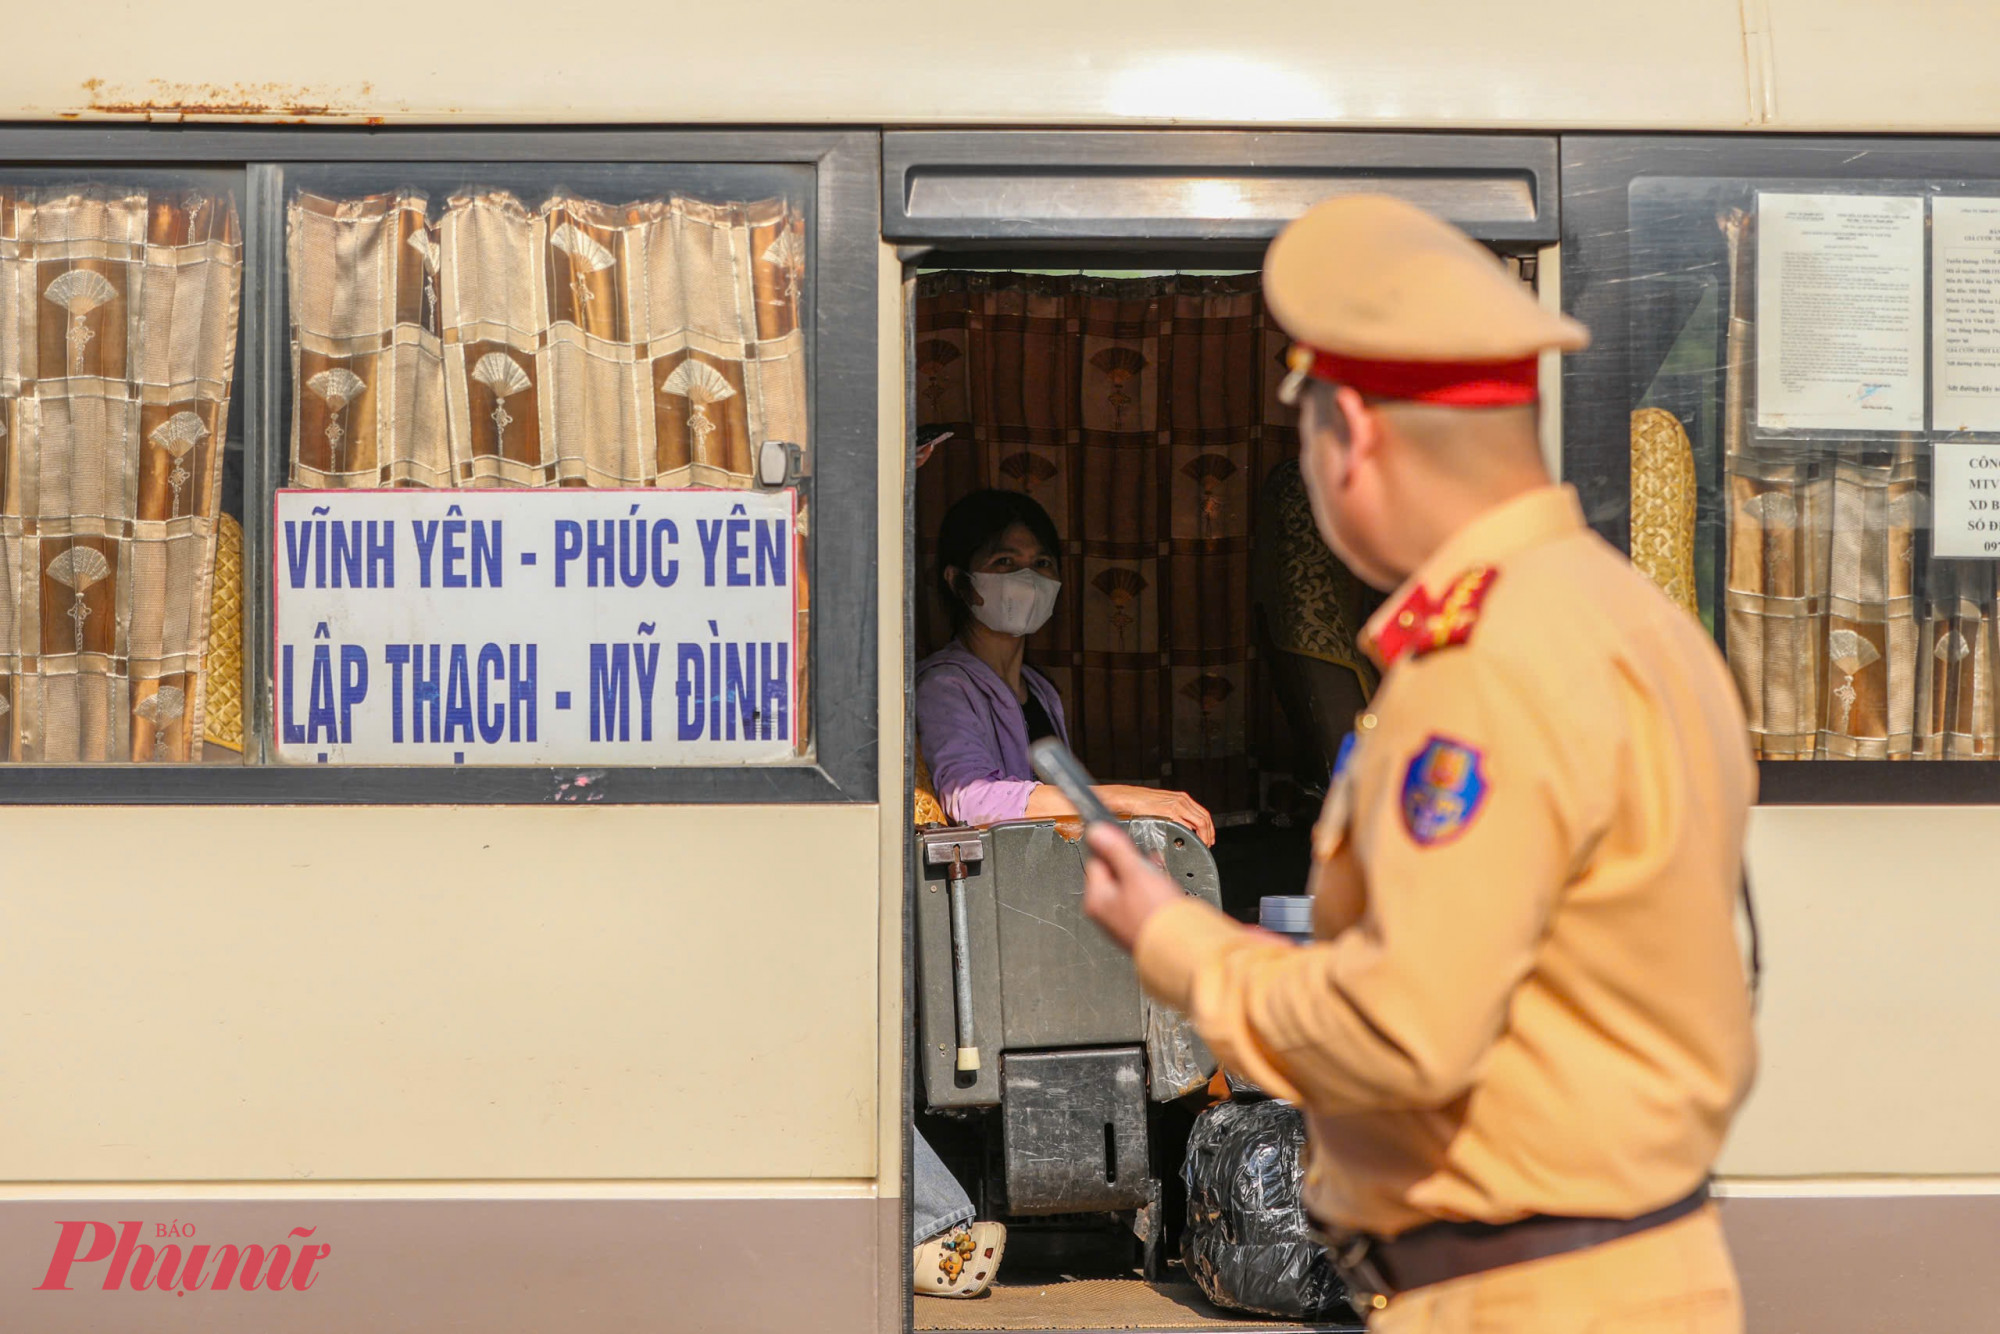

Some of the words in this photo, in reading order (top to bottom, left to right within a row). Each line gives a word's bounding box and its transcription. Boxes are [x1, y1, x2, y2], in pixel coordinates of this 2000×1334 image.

[1969, 456, 2000, 469] CÔN
[1969, 479, 2000, 490] MTV
[1969, 500, 1988, 511] XD
[284, 505, 395, 589] VĨNH
[411, 504, 502, 589] YÊN
[554, 503, 680, 588] PHÚC
[696, 503, 787, 588] YÊN
[281, 621, 369, 763] LẬP
[385, 641, 538, 764] THẠCH
[588, 621, 661, 743] MỸ
[674, 619, 788, 742] ĐÌNH
